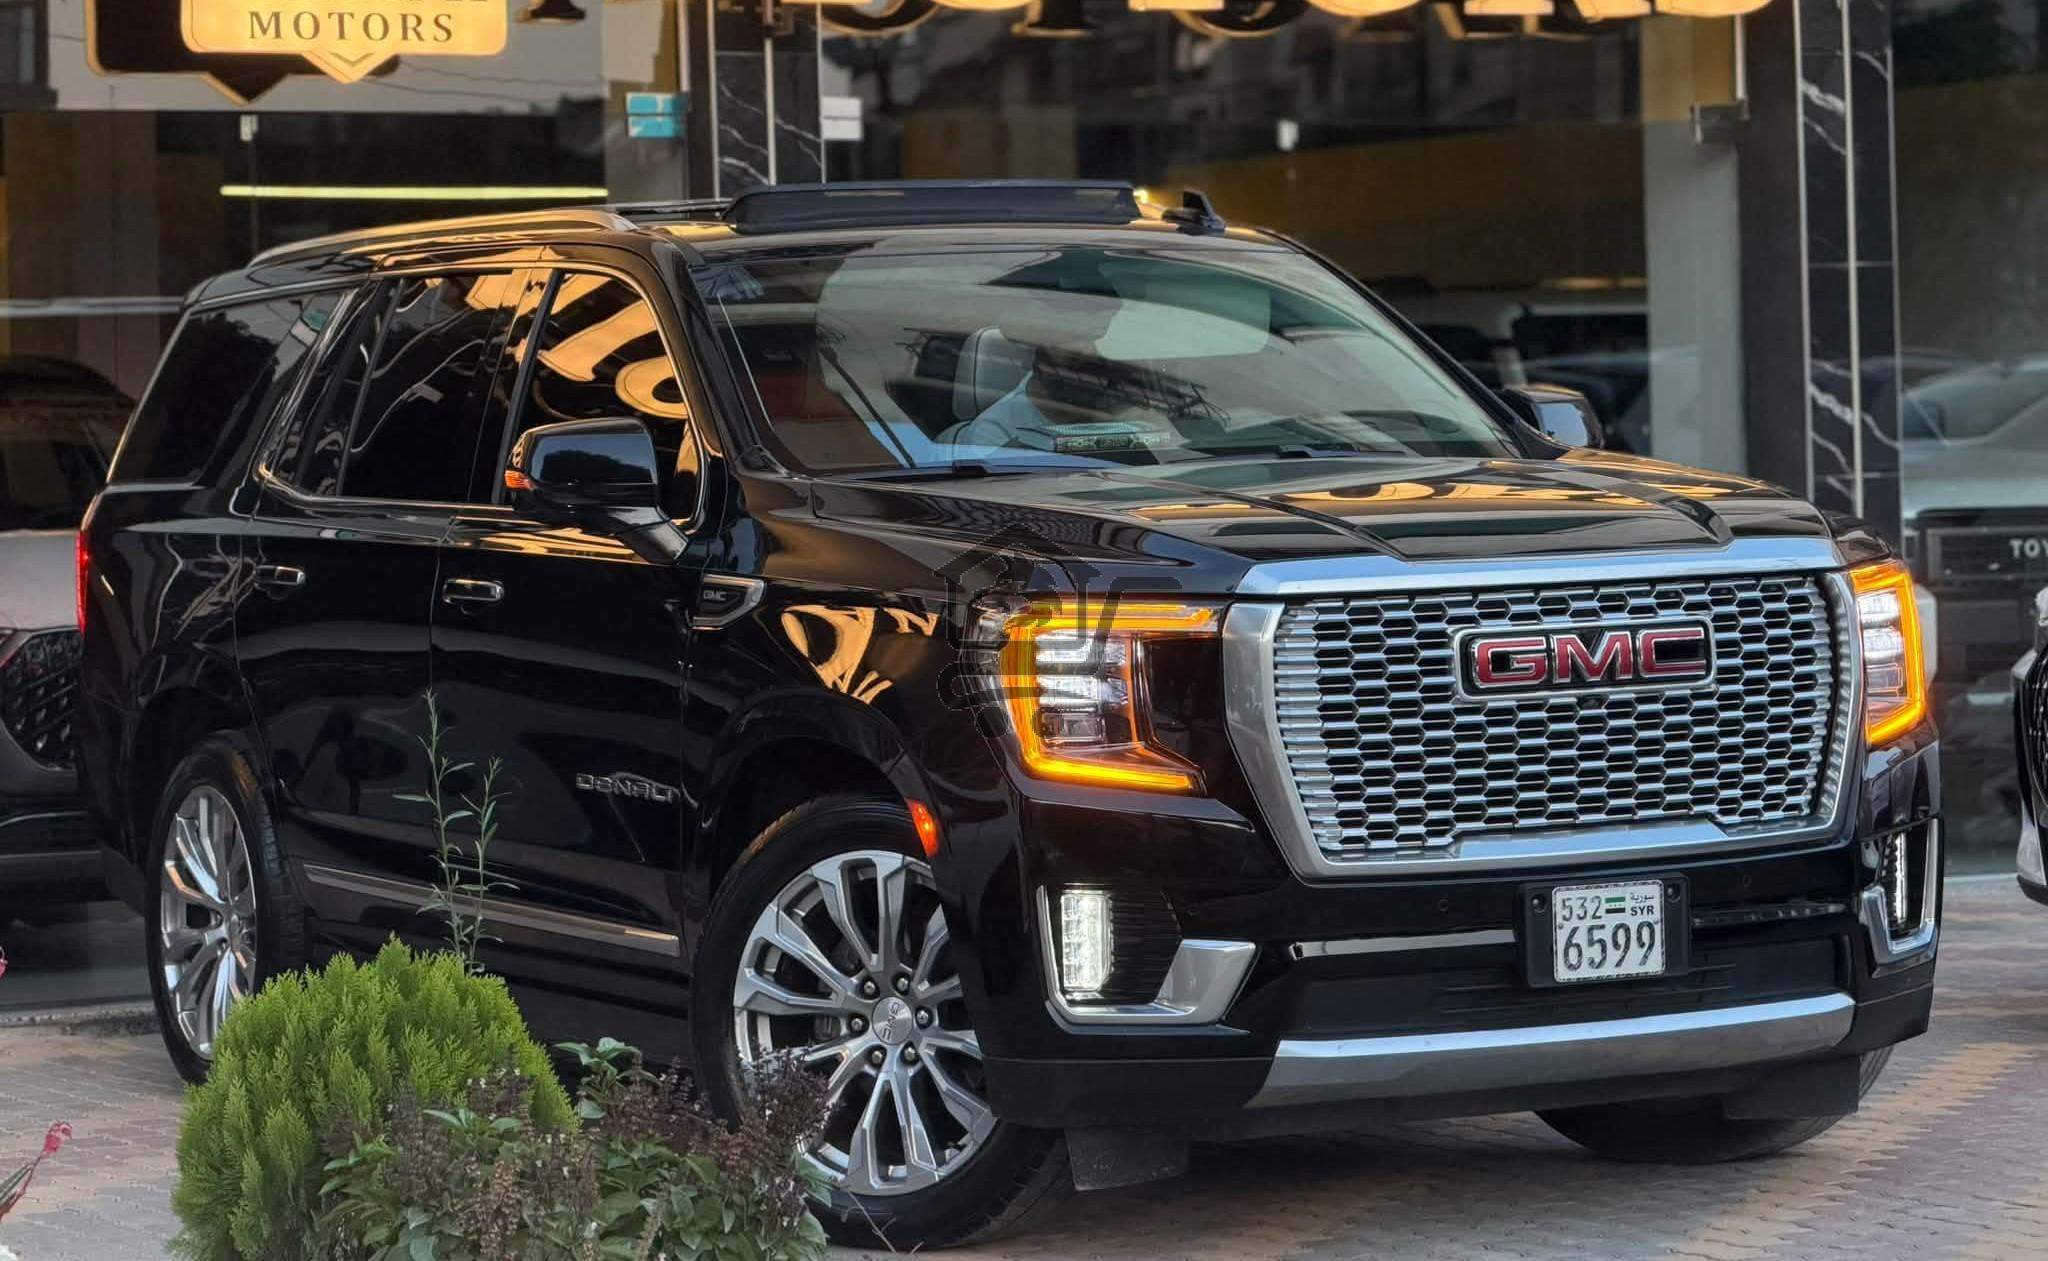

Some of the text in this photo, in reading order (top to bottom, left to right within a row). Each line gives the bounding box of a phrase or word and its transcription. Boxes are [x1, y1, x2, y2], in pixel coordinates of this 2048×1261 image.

[248, 10, 455, 43] MOTORS
[1472, 627, 1706, 689] GMC
[1561, 896, 1603, 920] 532
[1630, 905, 1655, 917] SYR
[1563, 920, 1656, 971] 6599
